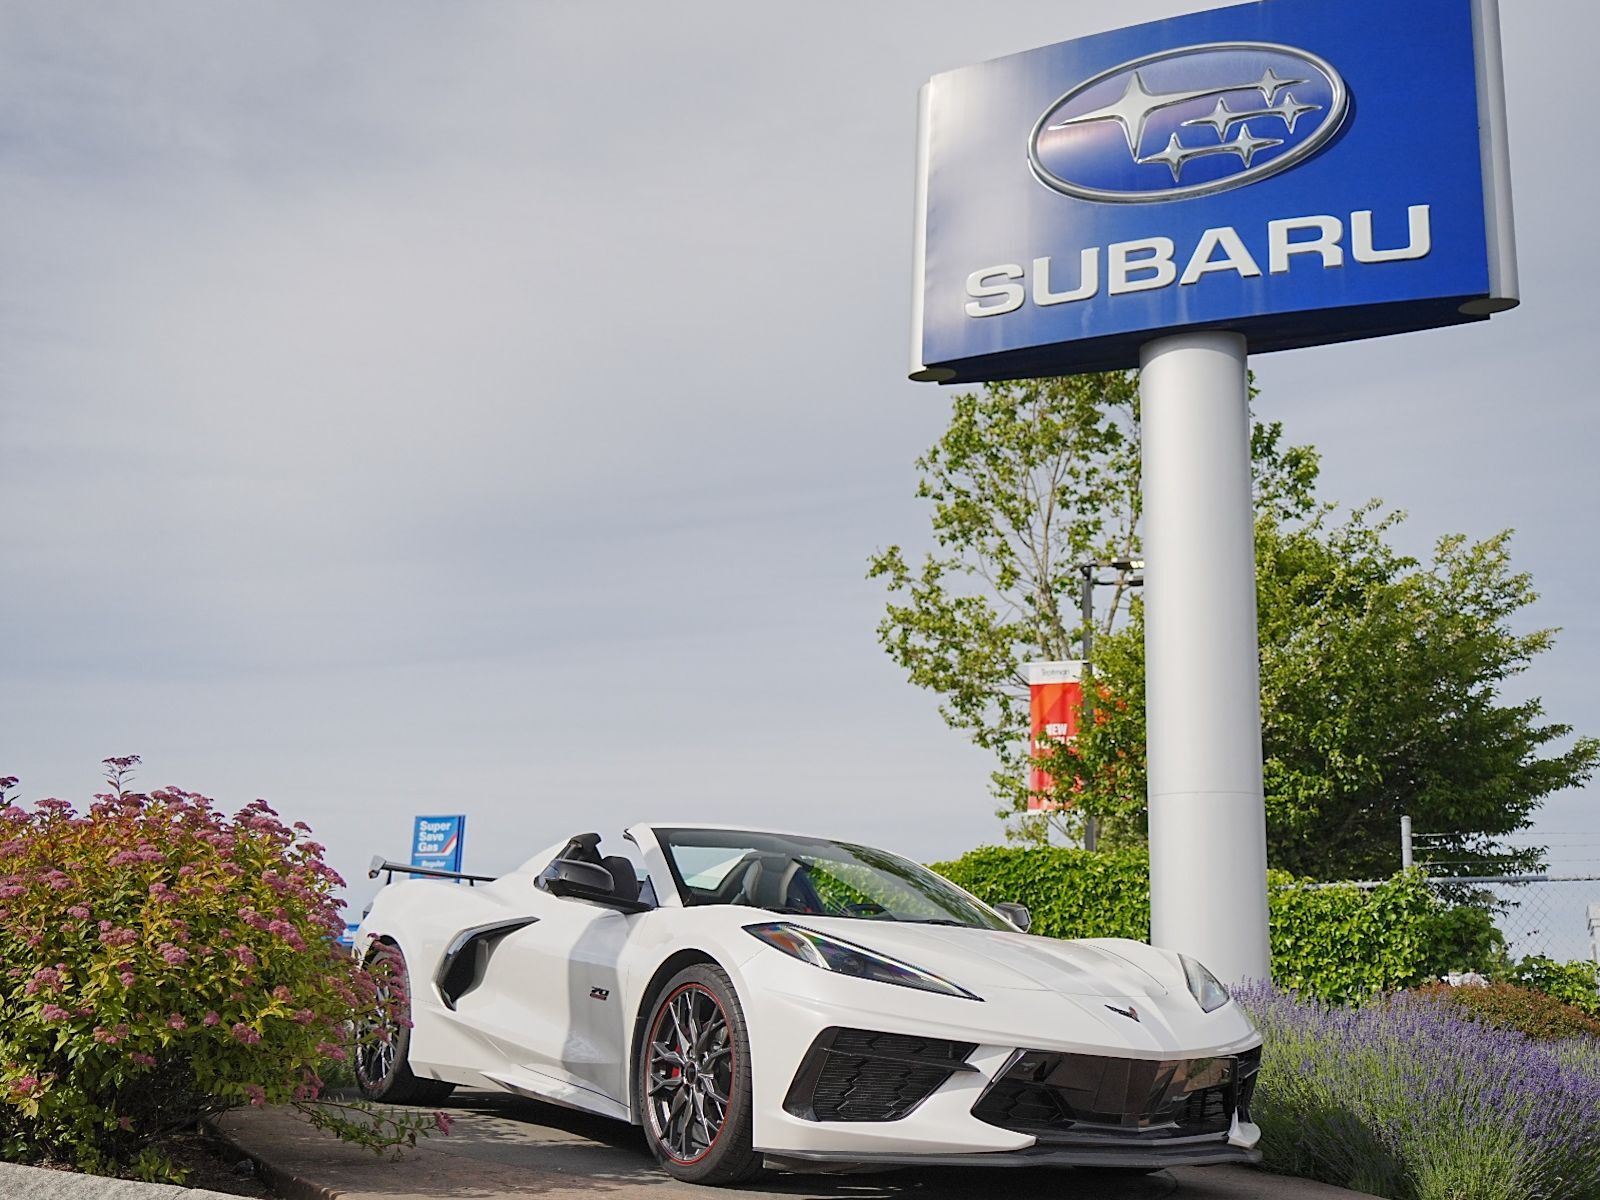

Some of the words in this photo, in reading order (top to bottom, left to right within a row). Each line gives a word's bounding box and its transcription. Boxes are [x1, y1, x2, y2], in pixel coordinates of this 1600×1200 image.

[964, 205, 1430, 318] SUBARU
[1046, 723, 1067, 735] NEW
[420, 821, 451, 832] Super
[419, 832, 444, 841] Save
[418, 842, 438, 851] Gas
